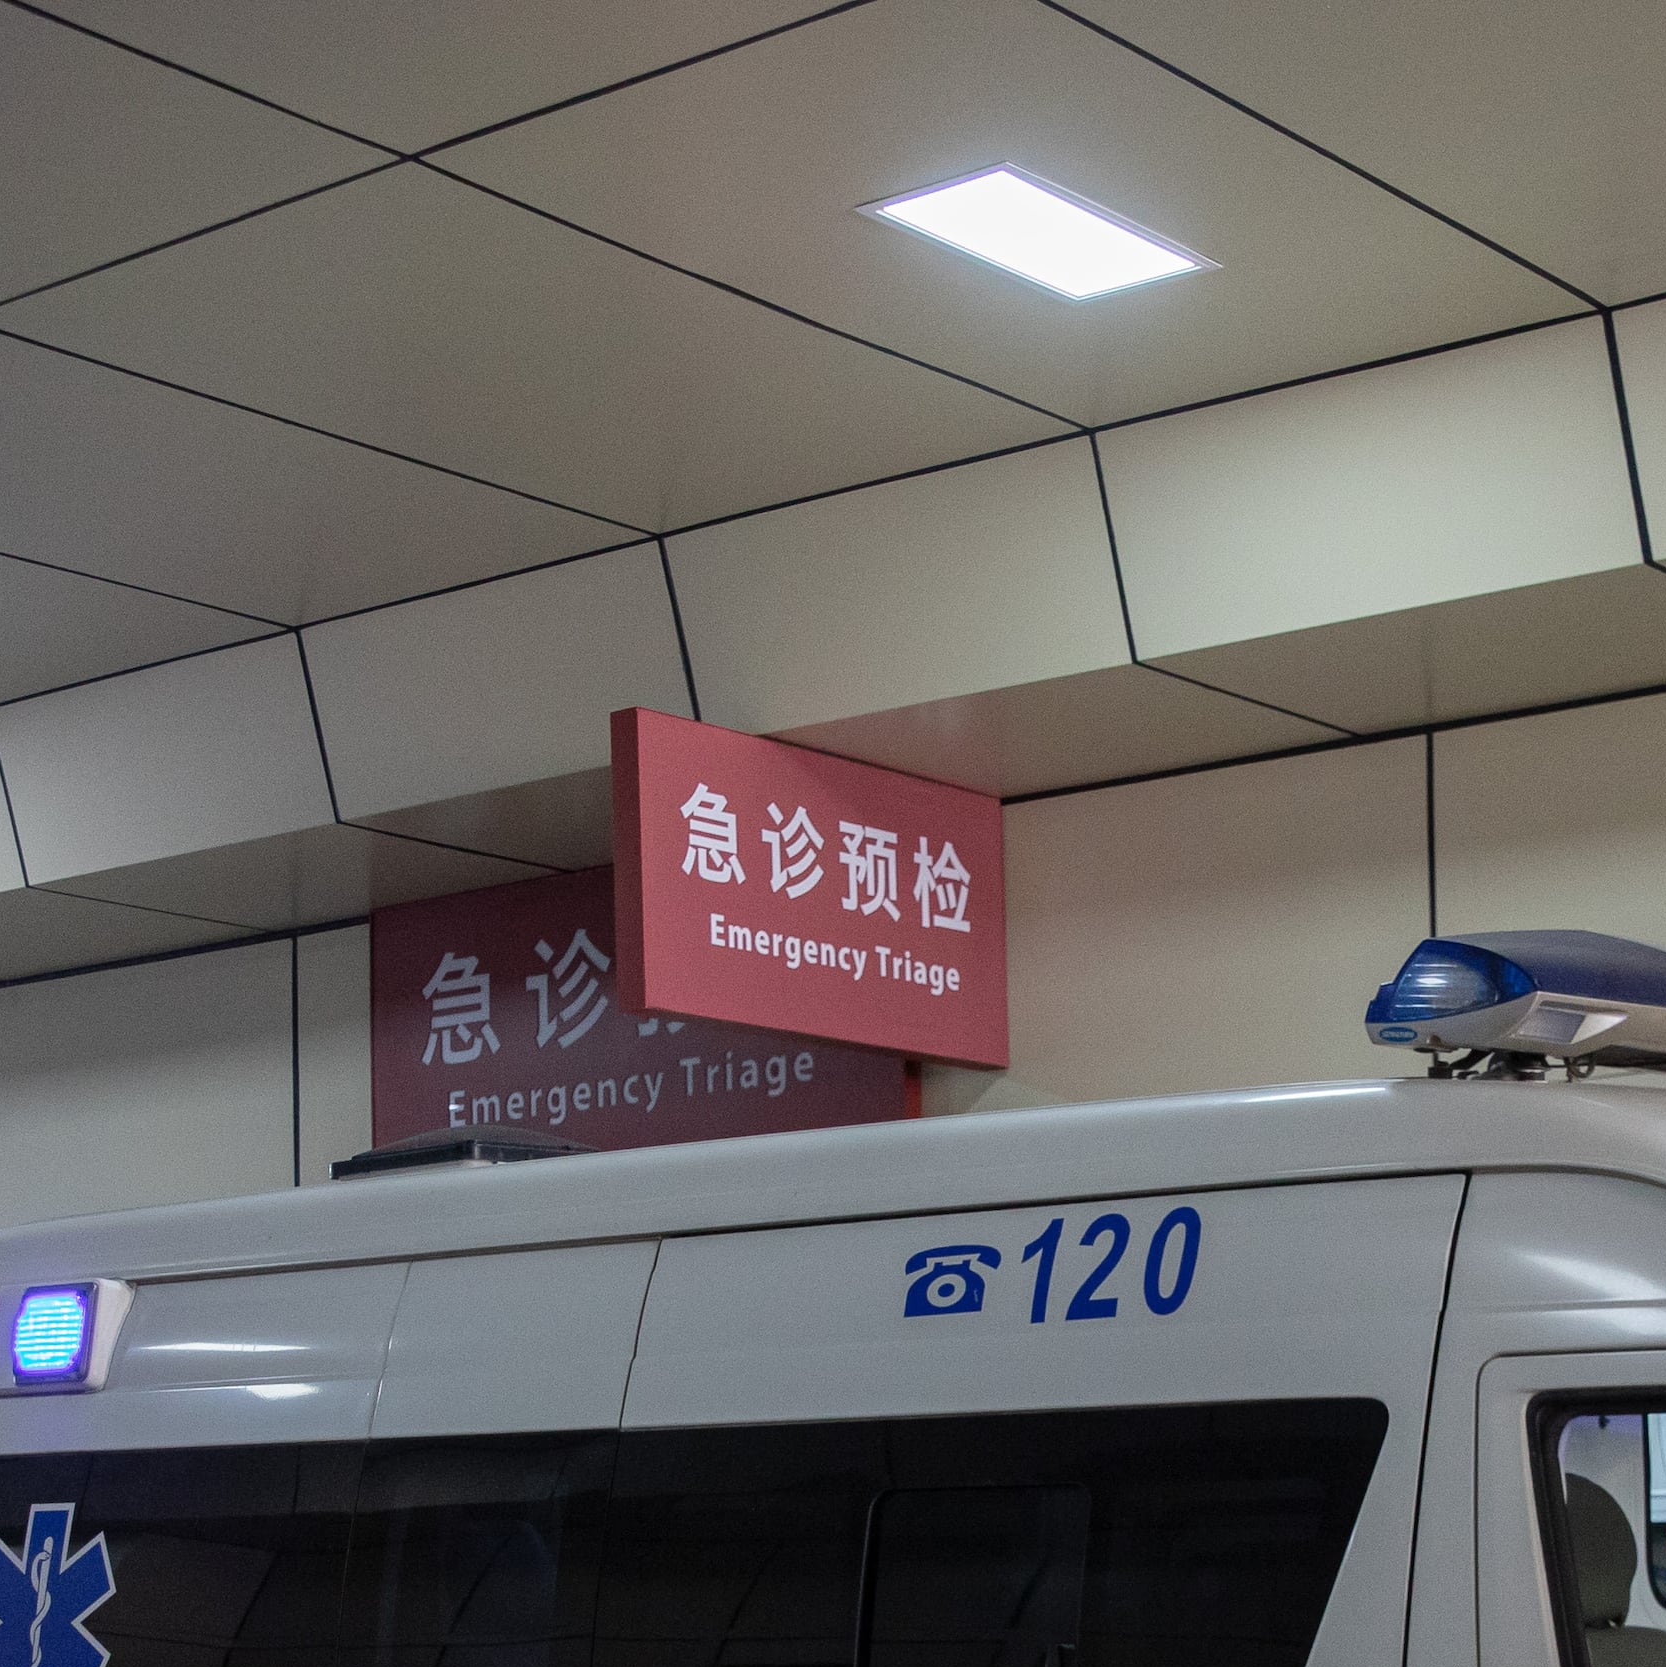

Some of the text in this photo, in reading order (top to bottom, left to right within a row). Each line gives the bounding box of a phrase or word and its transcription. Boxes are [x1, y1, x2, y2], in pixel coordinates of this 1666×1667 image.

[679, 782, 971, 933] 急诊预检
[421, 927, 685, 1067] 急诊
[709, 912, 961, 996] Emergency Triage
[448, 1050, 814, 1128] Emergency Triage
[1021, 1205, 1203, 1324] 120
